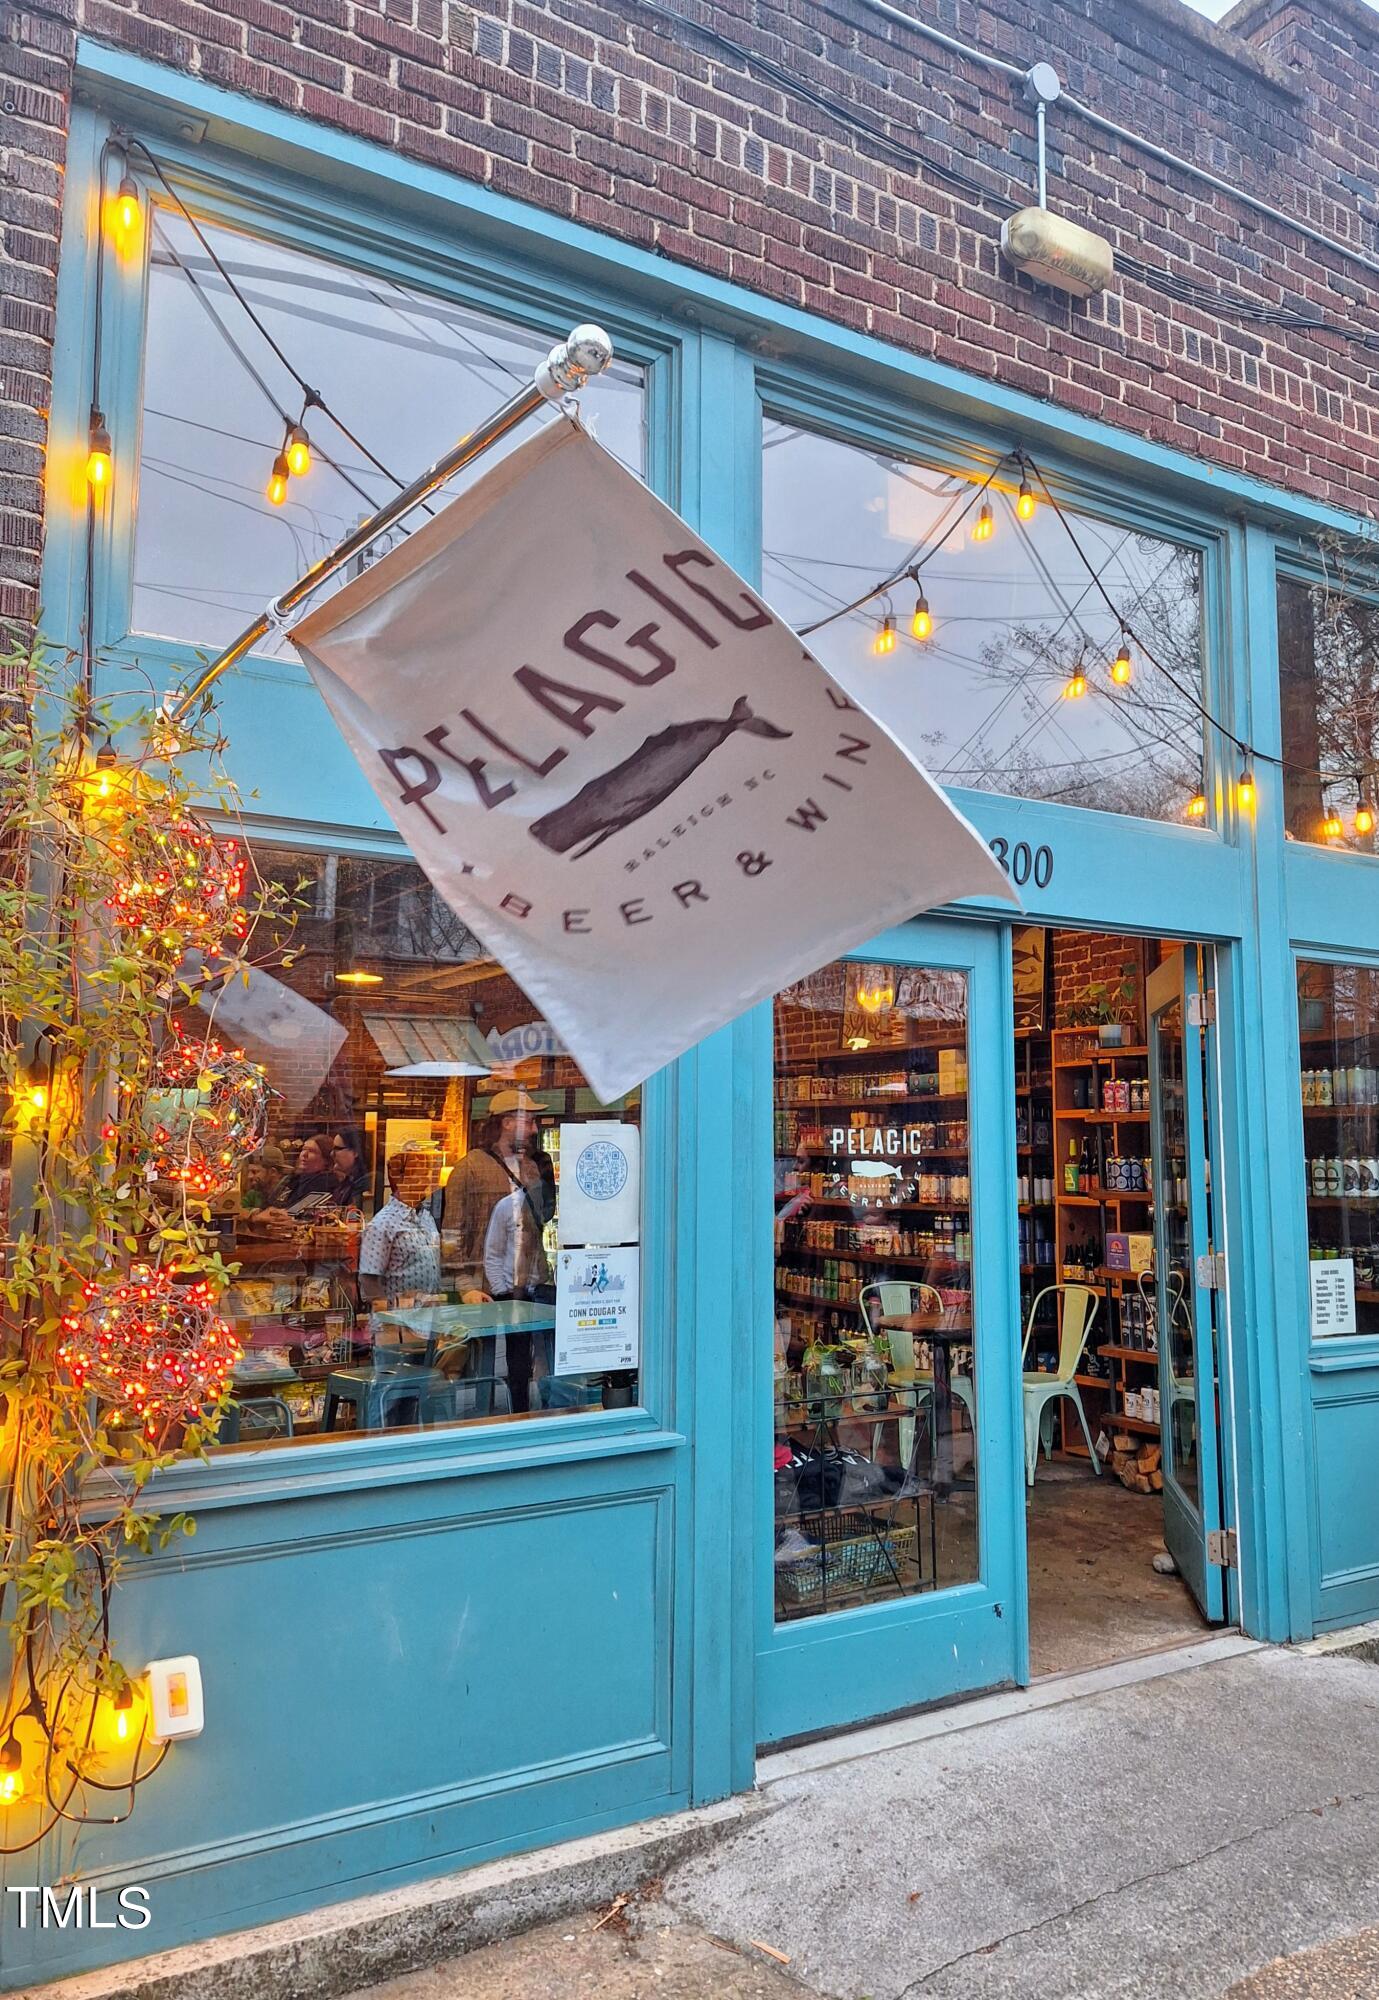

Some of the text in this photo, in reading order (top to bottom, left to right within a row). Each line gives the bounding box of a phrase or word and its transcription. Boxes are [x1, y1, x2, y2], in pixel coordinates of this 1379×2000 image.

[378, 549, 773, 835] PELAGIC
[624, 769, 776, 873] RALEIGH NC
[500, 880, 709, 933] BEER
[736, 851, 774, 877] &
[829, 1128, 921, 1154] PELAGIC
[832, 1171, 922, 1208] BEER & WINE
[569, 1308, 587, 1318] CONN
[588, 1306, 616, 1317] COUGAR
